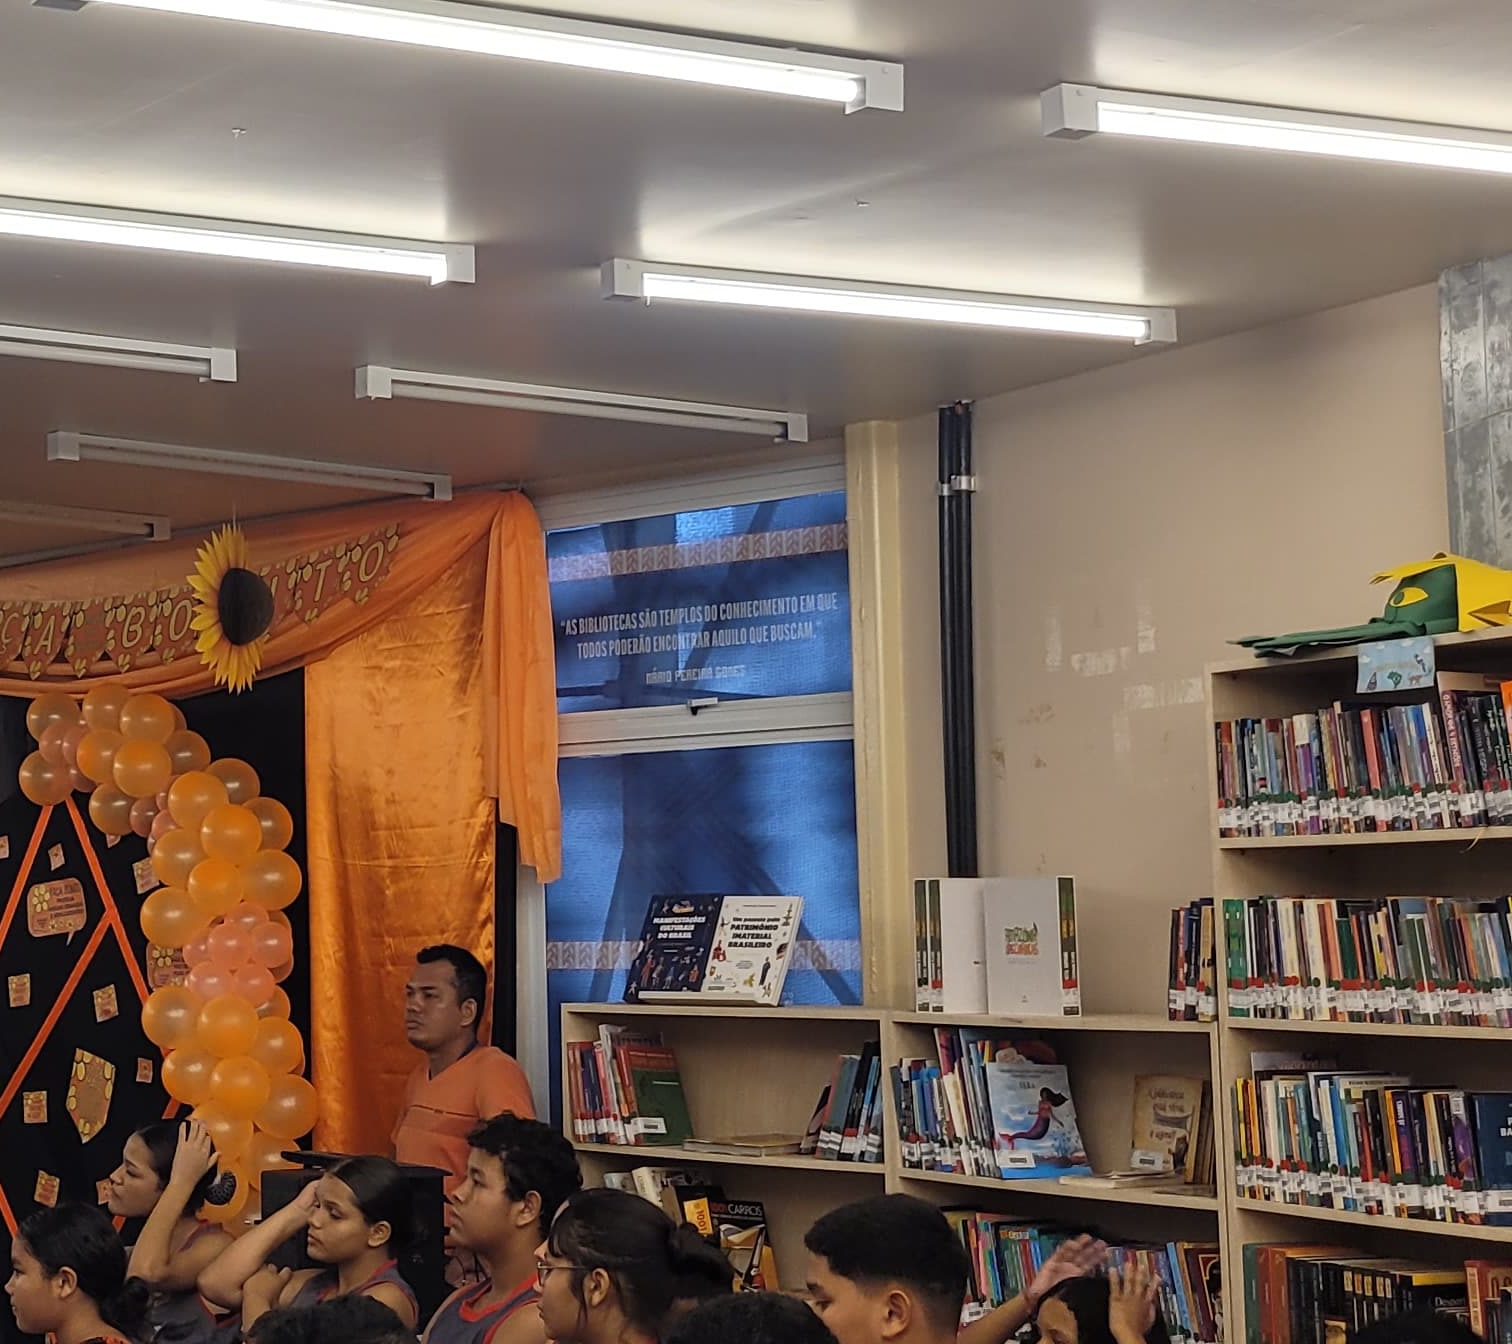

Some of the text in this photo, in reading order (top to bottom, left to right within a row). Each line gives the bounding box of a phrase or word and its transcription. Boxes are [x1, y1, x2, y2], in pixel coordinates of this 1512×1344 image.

[122, 539, 384, 644] BOITO
[579, 613, 637, 634] BIBLIOTECAS
[639, 608, 657, 629] SÃO
[659, 605, 702, 627] TEMPLOS
[704, 604, 718, 622] DO
[720, 596, 798, 621] CONHECIMENTO
[800, 594, 815, 613] EM
[816, 592, 838, 611] QUE
[577, 640, 607, 659] TODOS
[609, 634, 651, 656] PODERÃO
[653, 631, 710, 652] ENCONTRAR
[711, 626, 747, 646] AQUILO
[749, 625, 768, 644] QUE
[730, 923, 779, 931] PATRIMÔNIO
[732, 932, 773, 940] IMATERIAL
[727, 941, 773, 949] BRASILEIRO
[728, 1203, 763, 1216] CARROS
